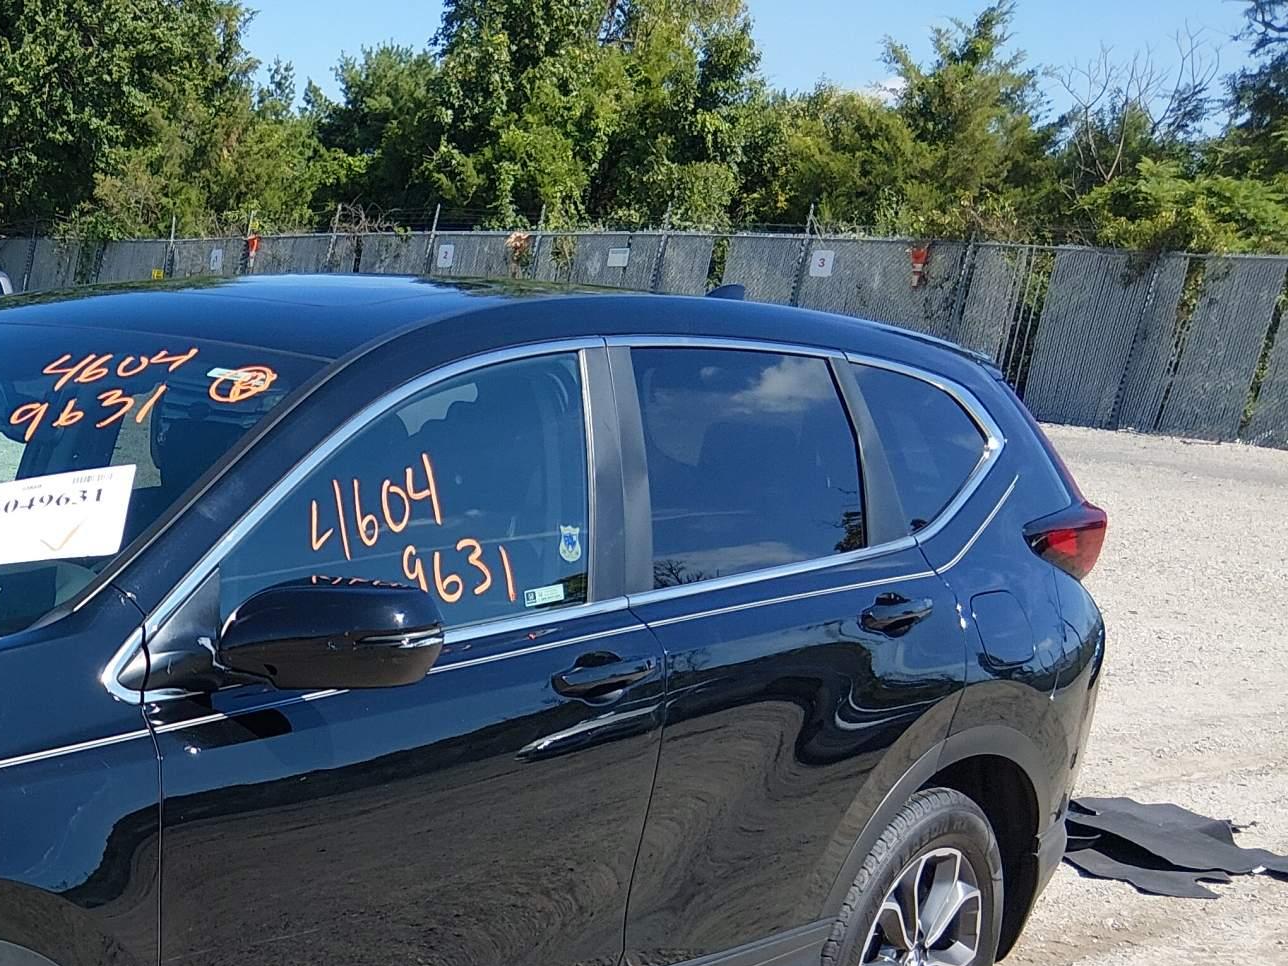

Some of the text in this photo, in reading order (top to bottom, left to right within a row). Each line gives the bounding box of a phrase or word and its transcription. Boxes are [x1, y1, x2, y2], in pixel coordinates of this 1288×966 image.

[443, 251, 448, 260] 2
[817, 257, 826, 268] 3
[42, 347, 199, 391] 4604
[9, 384, 167, 441] 9631
[312, 453, 443, 561] 4604
[402, 537, 516, 603] 9631
